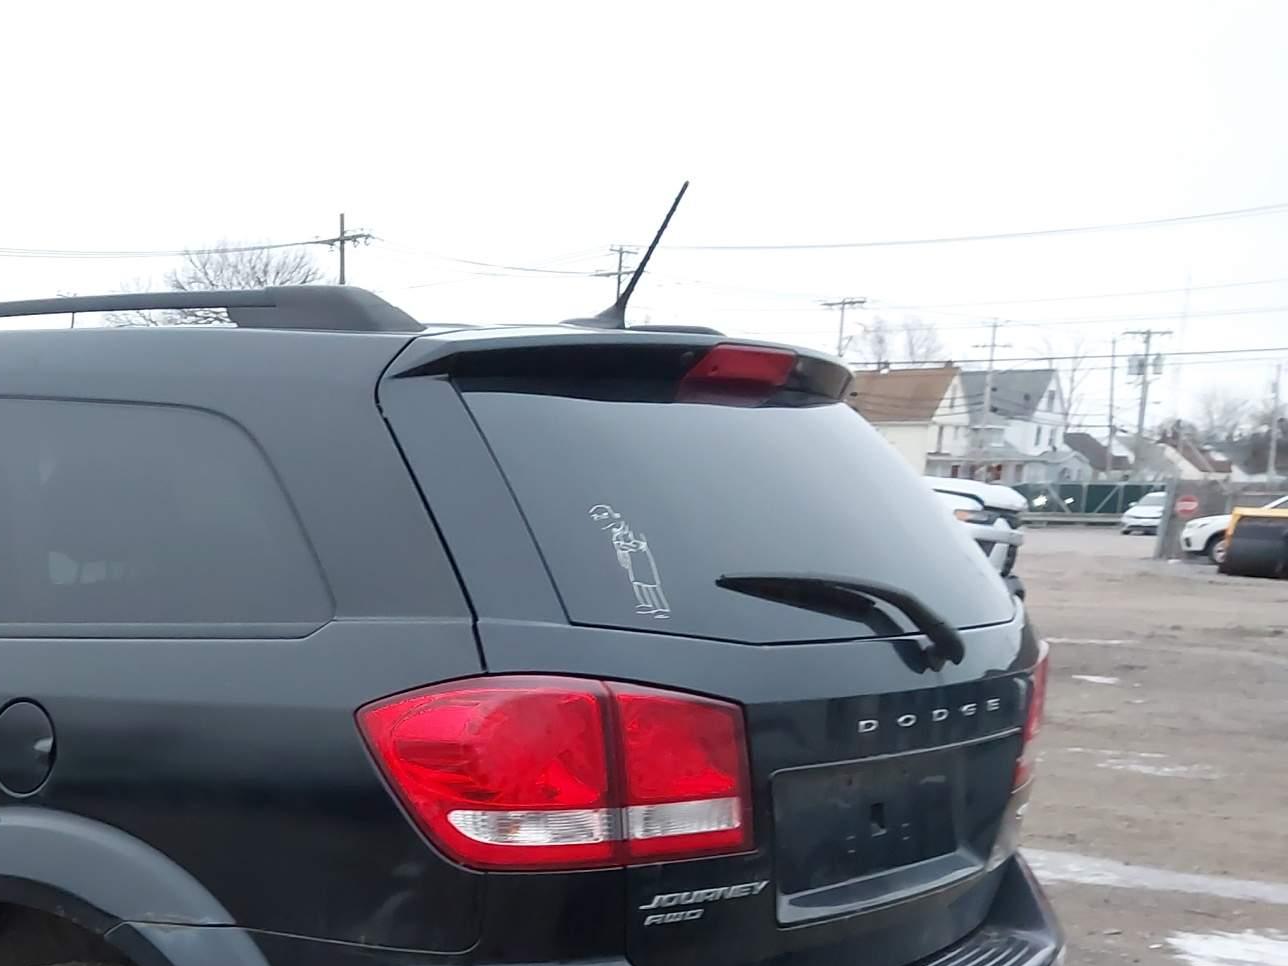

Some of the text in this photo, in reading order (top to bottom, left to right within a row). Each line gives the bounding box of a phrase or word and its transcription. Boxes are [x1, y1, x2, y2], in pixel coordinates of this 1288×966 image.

[857, 697, 1002, 734] DODGE
[638, 880, 770, 910] JOURNEY
[643, 908, 705, 926] AWD
